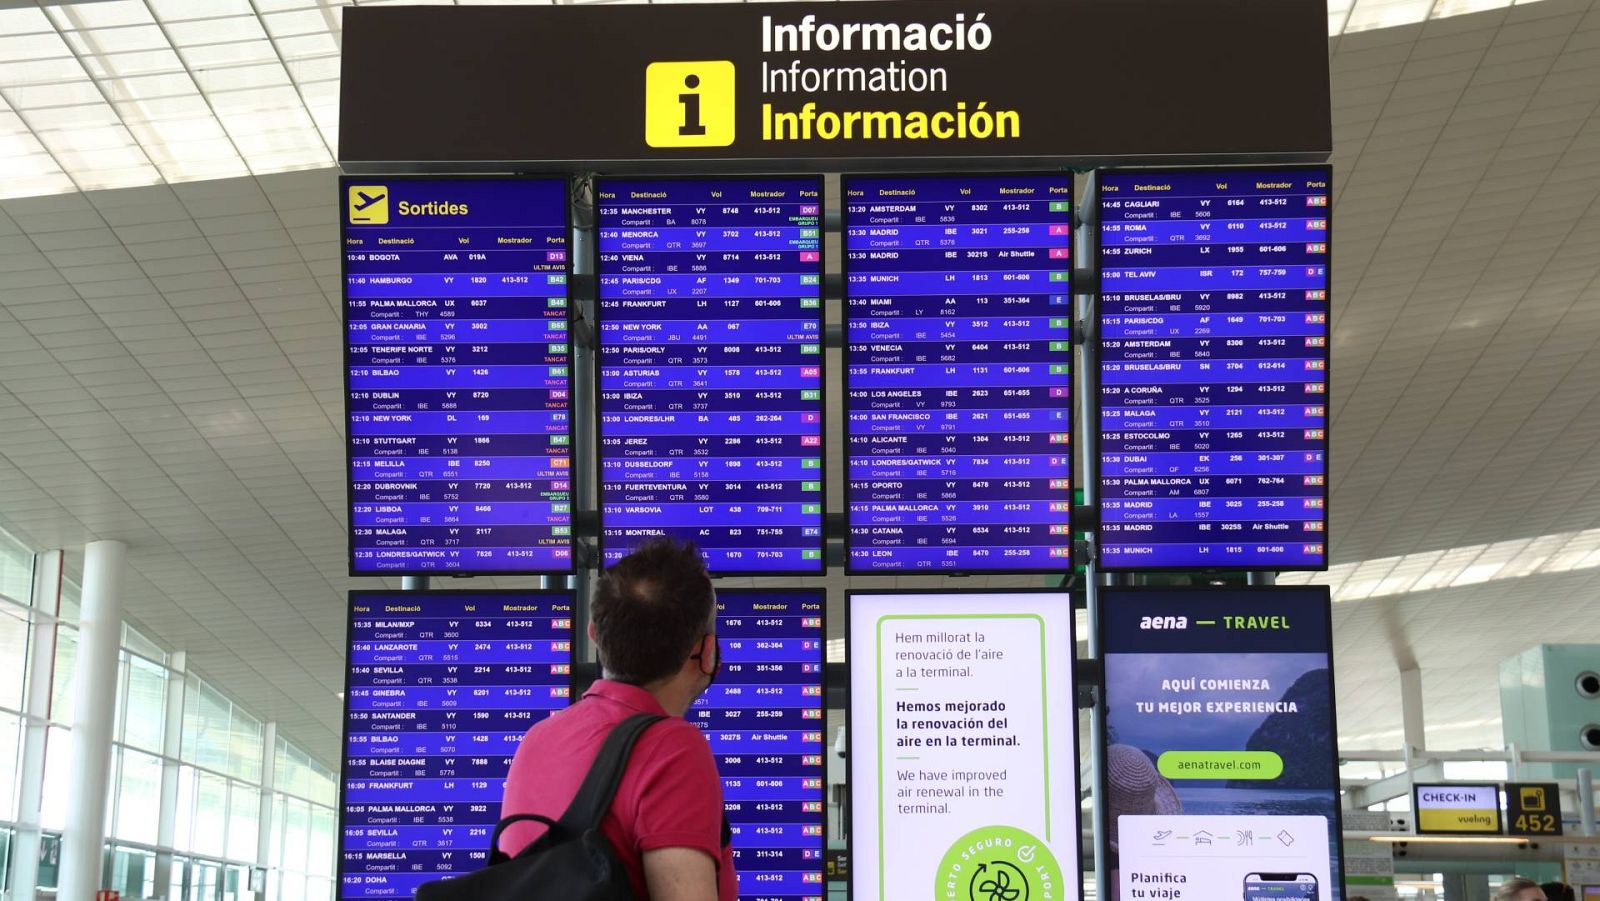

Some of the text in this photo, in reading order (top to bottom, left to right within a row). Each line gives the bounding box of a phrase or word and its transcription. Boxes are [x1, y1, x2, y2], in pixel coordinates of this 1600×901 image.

[763, 14, 991, 51] Informació
[763, 60, 946, 92] Information
[763, 102, 1019, 139] Información
[399, 201, 468, 215] Sortides
[1140, 616, 1290, 629] aena TRAVEL
[896, 632, 984, 643] Hem millorat la
[896, 649, 1003, 660] renovació de l'aire
[896, 667, 972, 677] a la terminal.
[1162, 677, 1270, 692] AQUÍ COMIENZA
[897, 701, 1005, 714] Hemos mejorado
[1136, 701, 1298, 714] TU MEJOR EXPERIENCIA
[897, 718, 1007, 729] la renovación del
[897, 736, 1020, 746] aire en la terminal.
[1178, 760, 1261, 770] aenatravel.com
[897, 770, 1006, 782] We have improved
[898, 786, 1003, 797] air renewal in the
[1423, 793, 1476, 802] CHECK-IN
[899, 803, 951, 813] terminal.
[1458, 815, 1491, 825] vueling
[1515, 815, 1555, 832] 452
[947, 838, 1011, 901] ERTO SEGURO
[1036, 865, 1052, 899] PORT
[1132, 873, 1186, 883] Planifica
[1132, 888, 1180, 900] tu viaje
